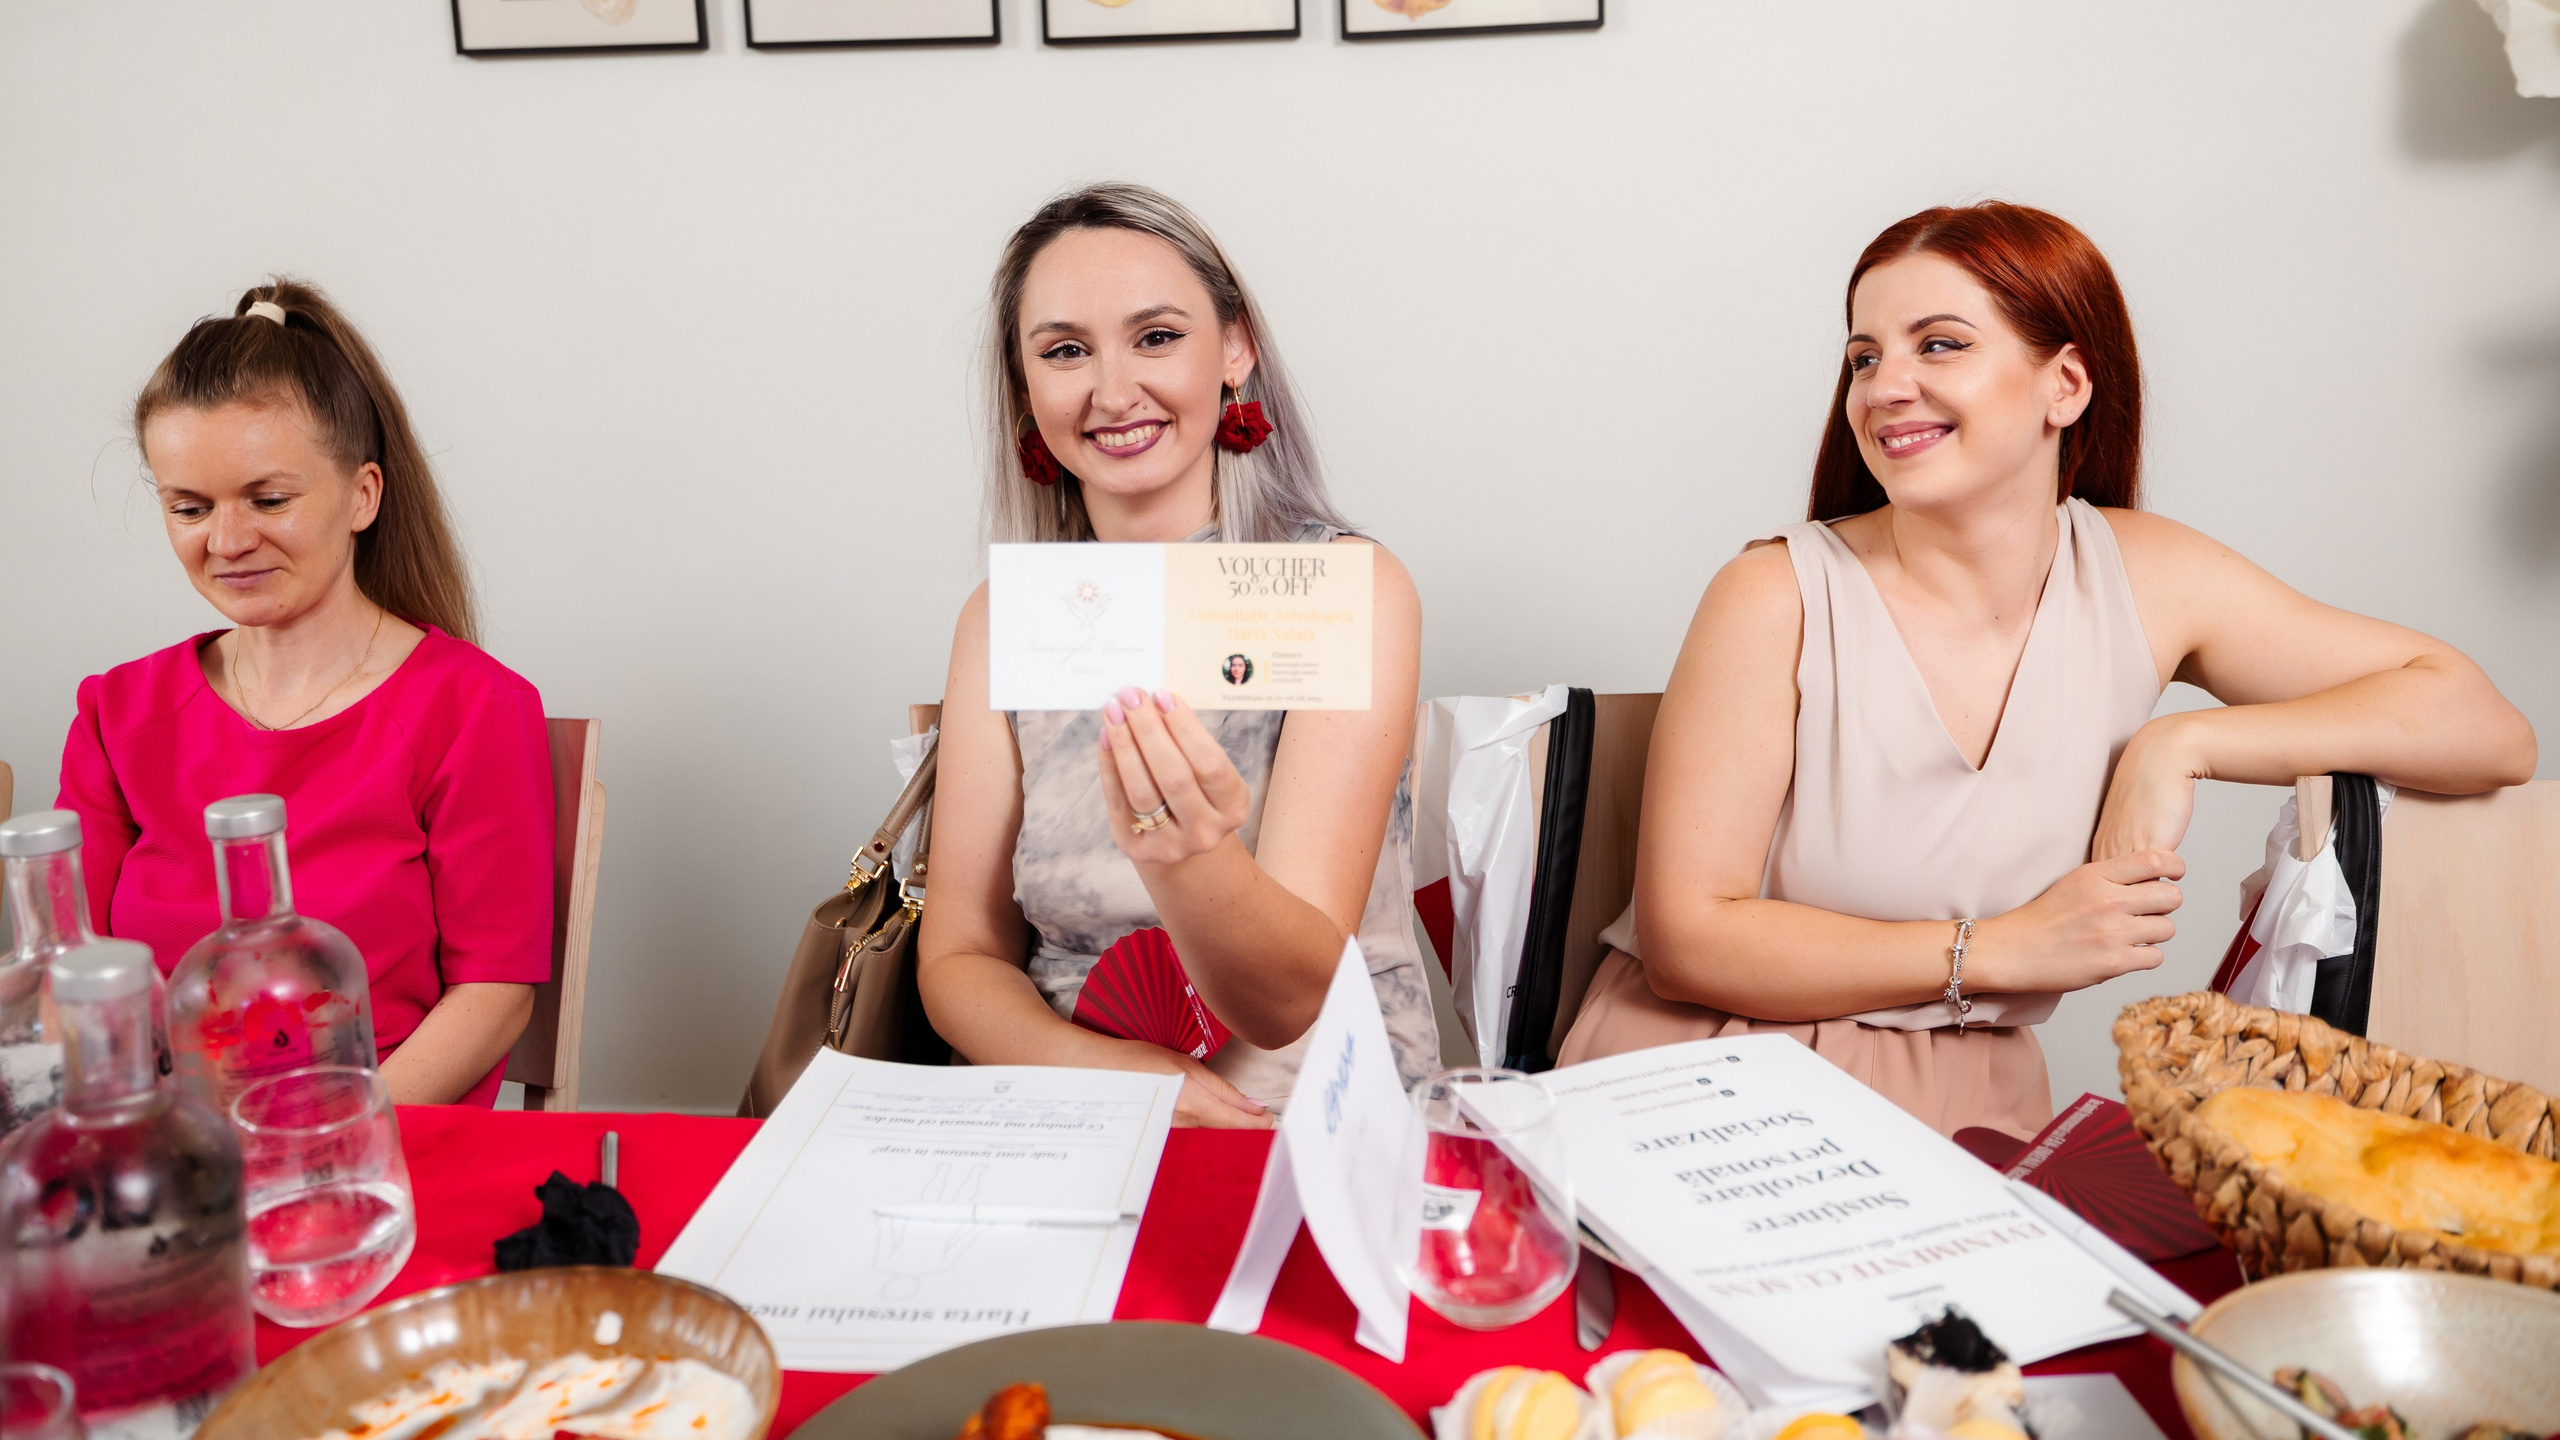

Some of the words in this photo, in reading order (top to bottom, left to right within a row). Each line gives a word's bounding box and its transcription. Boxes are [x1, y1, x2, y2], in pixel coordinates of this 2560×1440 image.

[1217, 557, 1327, 578] VOUCHER
[1229, 574, 1269, 600] 50%
[1272, 577, 1316, 597] OFF
[1227, 627, 1267, 641] Harta
[1271, 627, 1317, 641] Natală
[1086, 1123, 1104, 1133] Ce
[1632, 1110, 1815, 1154] Socializare
[931, 1149, 993, 1160] tensiune
[1031, 1151, 1068, 1162] Unde
[1675, 1137, 1845, 1188] personală
[1696, 1159, 1884, 1206] Dezvoltare
[1745, 1189, 1911, 1234] Susținere
[1851, 1220, 2049, 1281] EVENIMENTE
[1799, 1271, 1844, 1289] CU
[806, 1305, 936, 1325] stresului
[943, 1308, 1031, 1328] Harta
